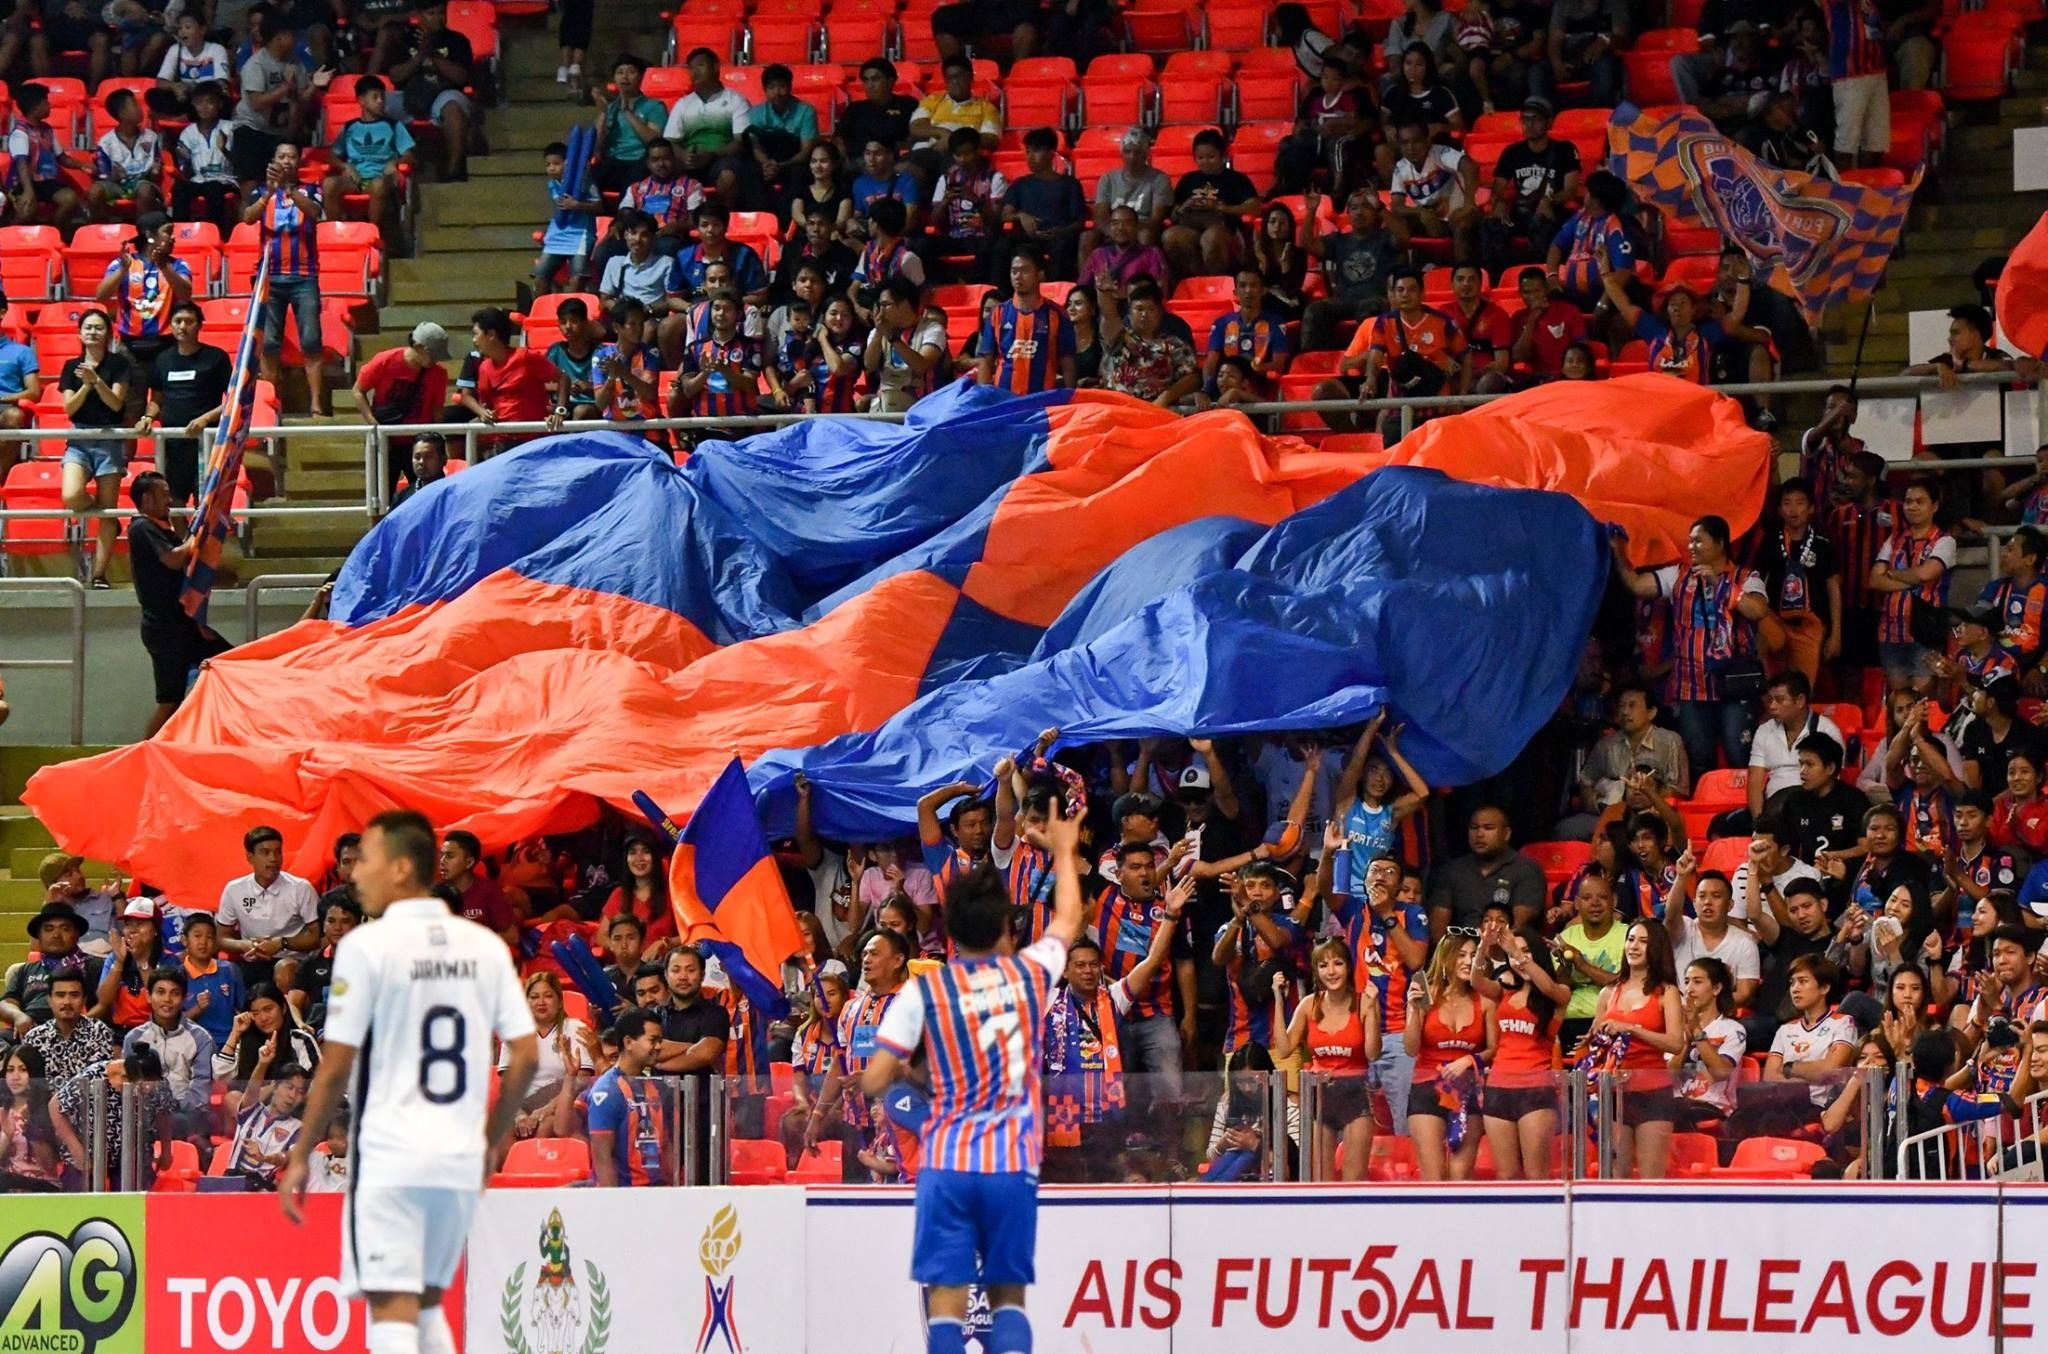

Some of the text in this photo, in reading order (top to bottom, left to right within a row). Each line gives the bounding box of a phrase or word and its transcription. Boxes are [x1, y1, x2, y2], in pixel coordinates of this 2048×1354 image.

[1348, 829, 1373, 847] PORT
[1814, 835, 1830, 857] 2
[242, 897, 257, 908] SP
[409, 959, 478, 981] JIRAWAT
[1498, 1018, 1536, 1035] FHM
[419, 1004, 467, 1105] 8
[977, 1011, 1027, 1097] 7
[1313, 1044, 1353, 1058] FHM
[1437, 1039, 1477, 1051] FHM
[1062, 1257, 1184, 1331] AIS
[1519, 1257, 2038, 1338] THAILEAGUE
[166, 1275, 371, 1351] TOYO
[2, 1335, 79, 1351] ADVANCED
